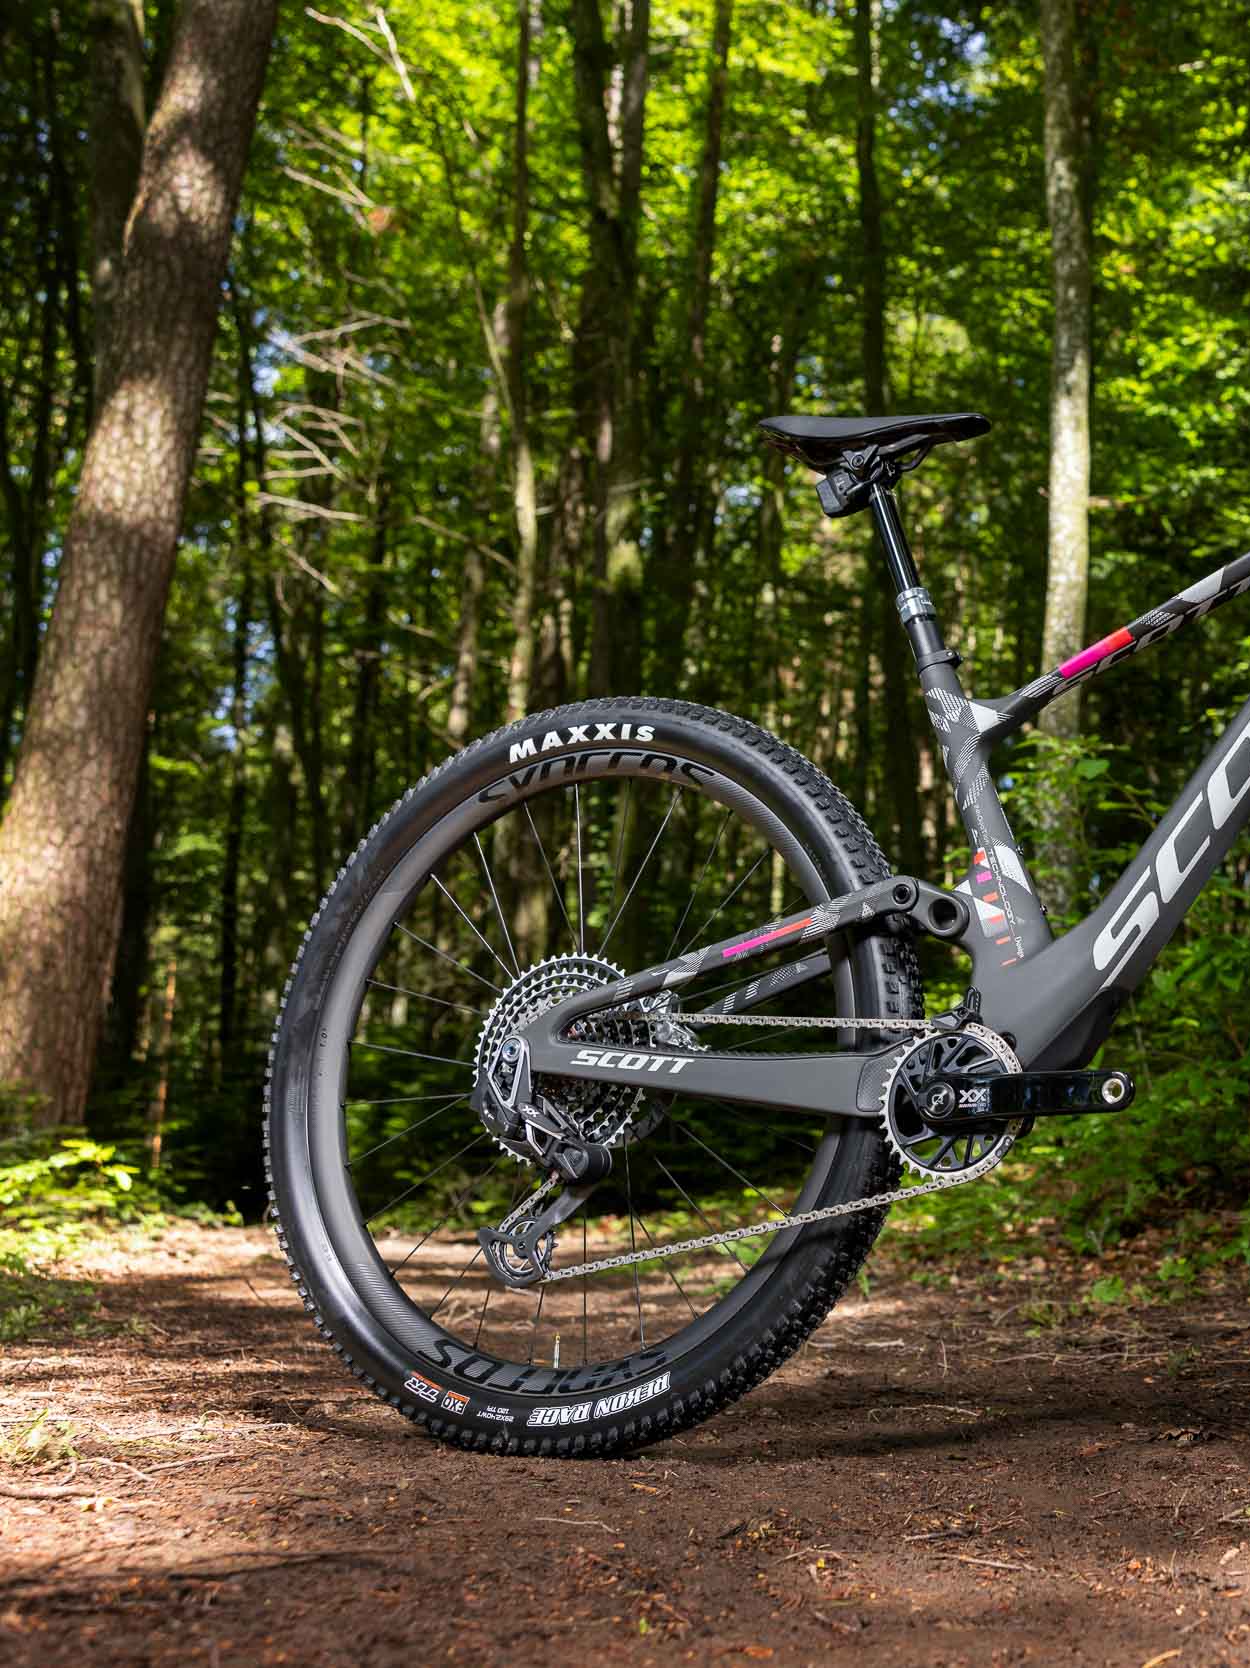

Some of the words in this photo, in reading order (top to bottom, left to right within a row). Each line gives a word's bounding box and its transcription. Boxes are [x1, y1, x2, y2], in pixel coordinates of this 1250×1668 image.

[508, 722, 656, 764] MAXXIS
[570, 1048, 695, 1074] SCOTT
[522, 1104, 540, 1118] XX
[403, 1376, 440, 1404] TR
[595, 1371, 671, 1418] REKON
[442, 1396, 466, 1414] EXO
[527, 1401, 593, 1427] RACE
